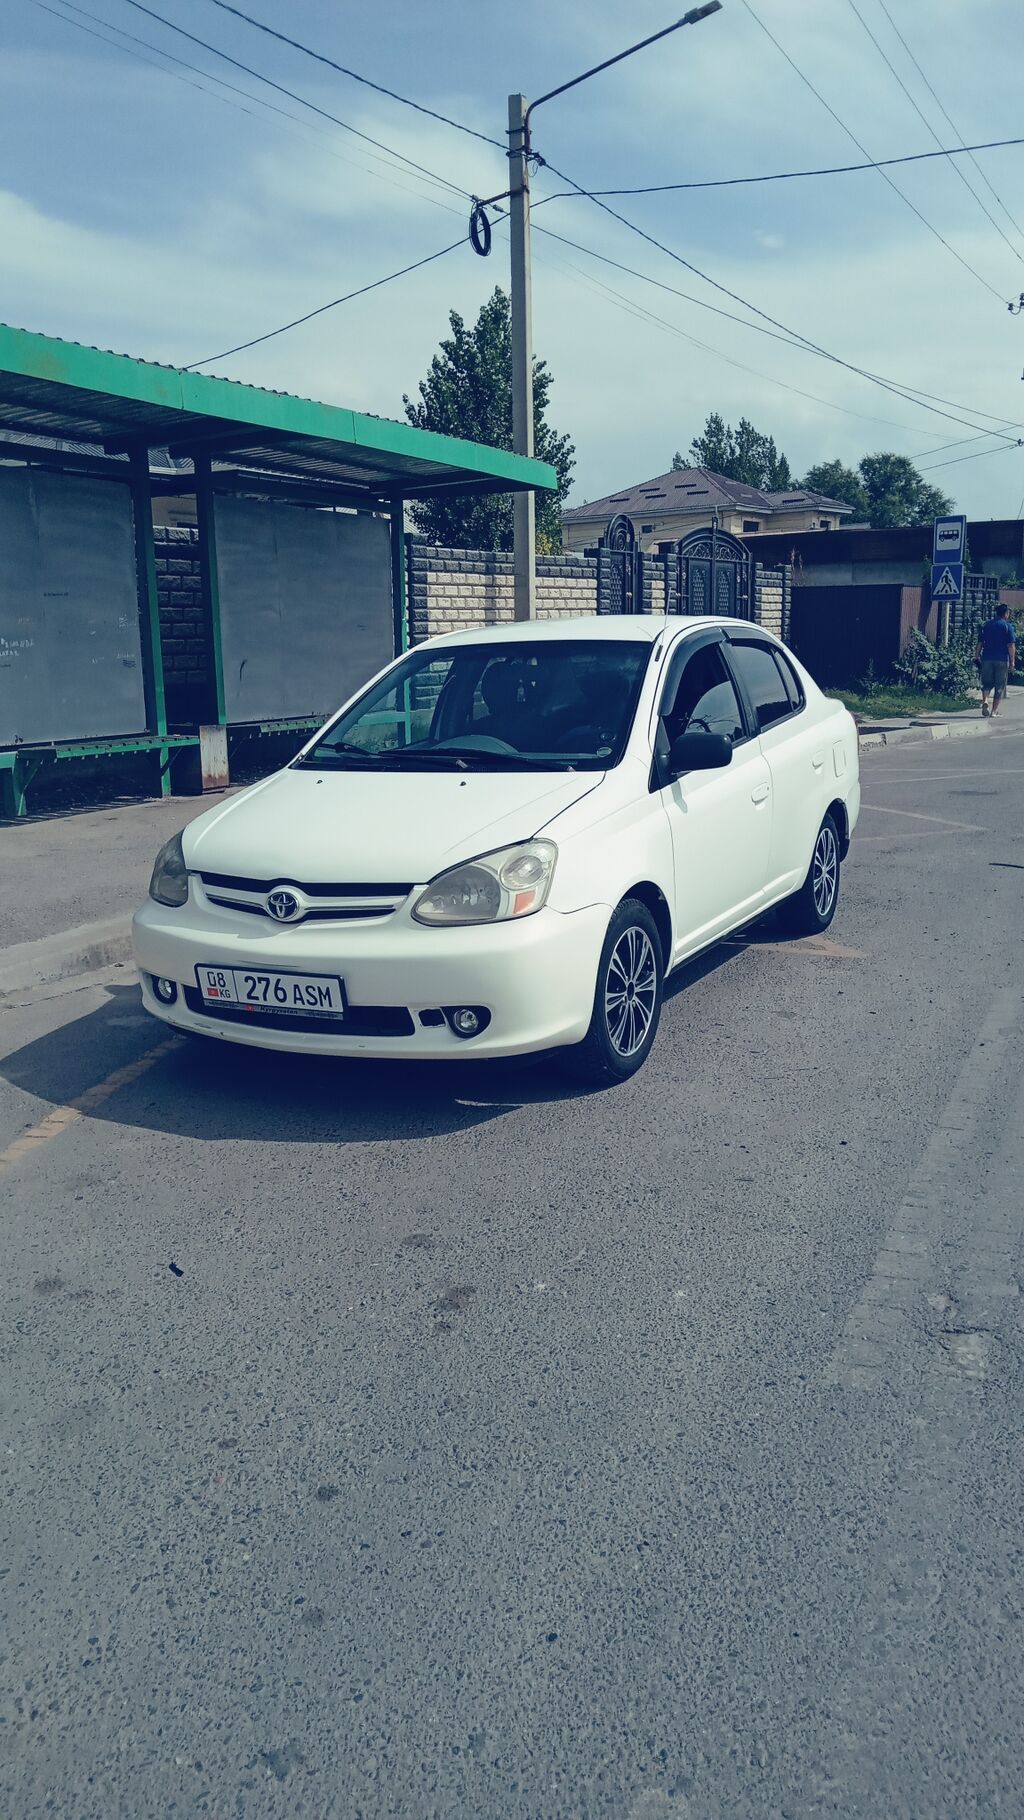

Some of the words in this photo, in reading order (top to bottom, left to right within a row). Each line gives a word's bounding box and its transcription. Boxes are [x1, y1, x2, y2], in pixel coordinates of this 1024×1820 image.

[207, 971, 226, 987] 08
[244, 976, 288, 1003] 276
[293, 984, 333, 1008] ASM
[219, 988, 231, 998] KG
